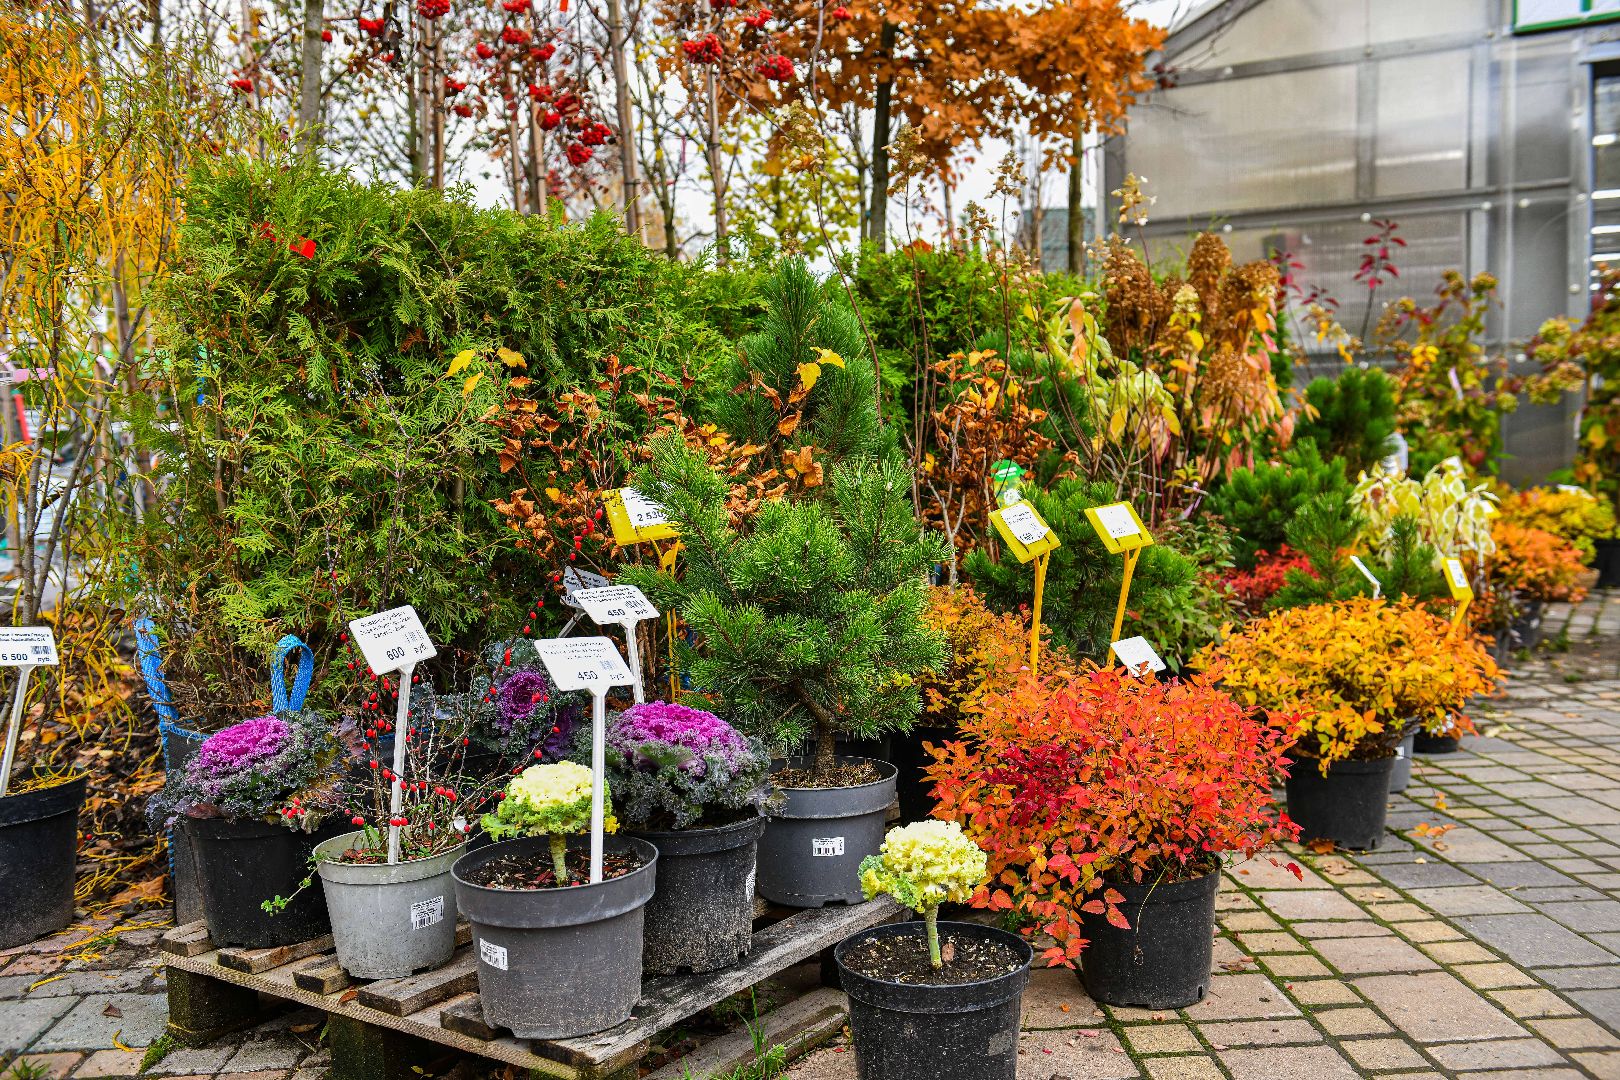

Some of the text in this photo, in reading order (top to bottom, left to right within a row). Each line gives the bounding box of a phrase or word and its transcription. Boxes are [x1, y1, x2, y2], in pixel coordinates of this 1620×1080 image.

[637, 513, 643, 521] 2
[607, 609, 626, 617] 450
[386, 646, 404, 660] 600
[578, 670, 598, 681] 450
